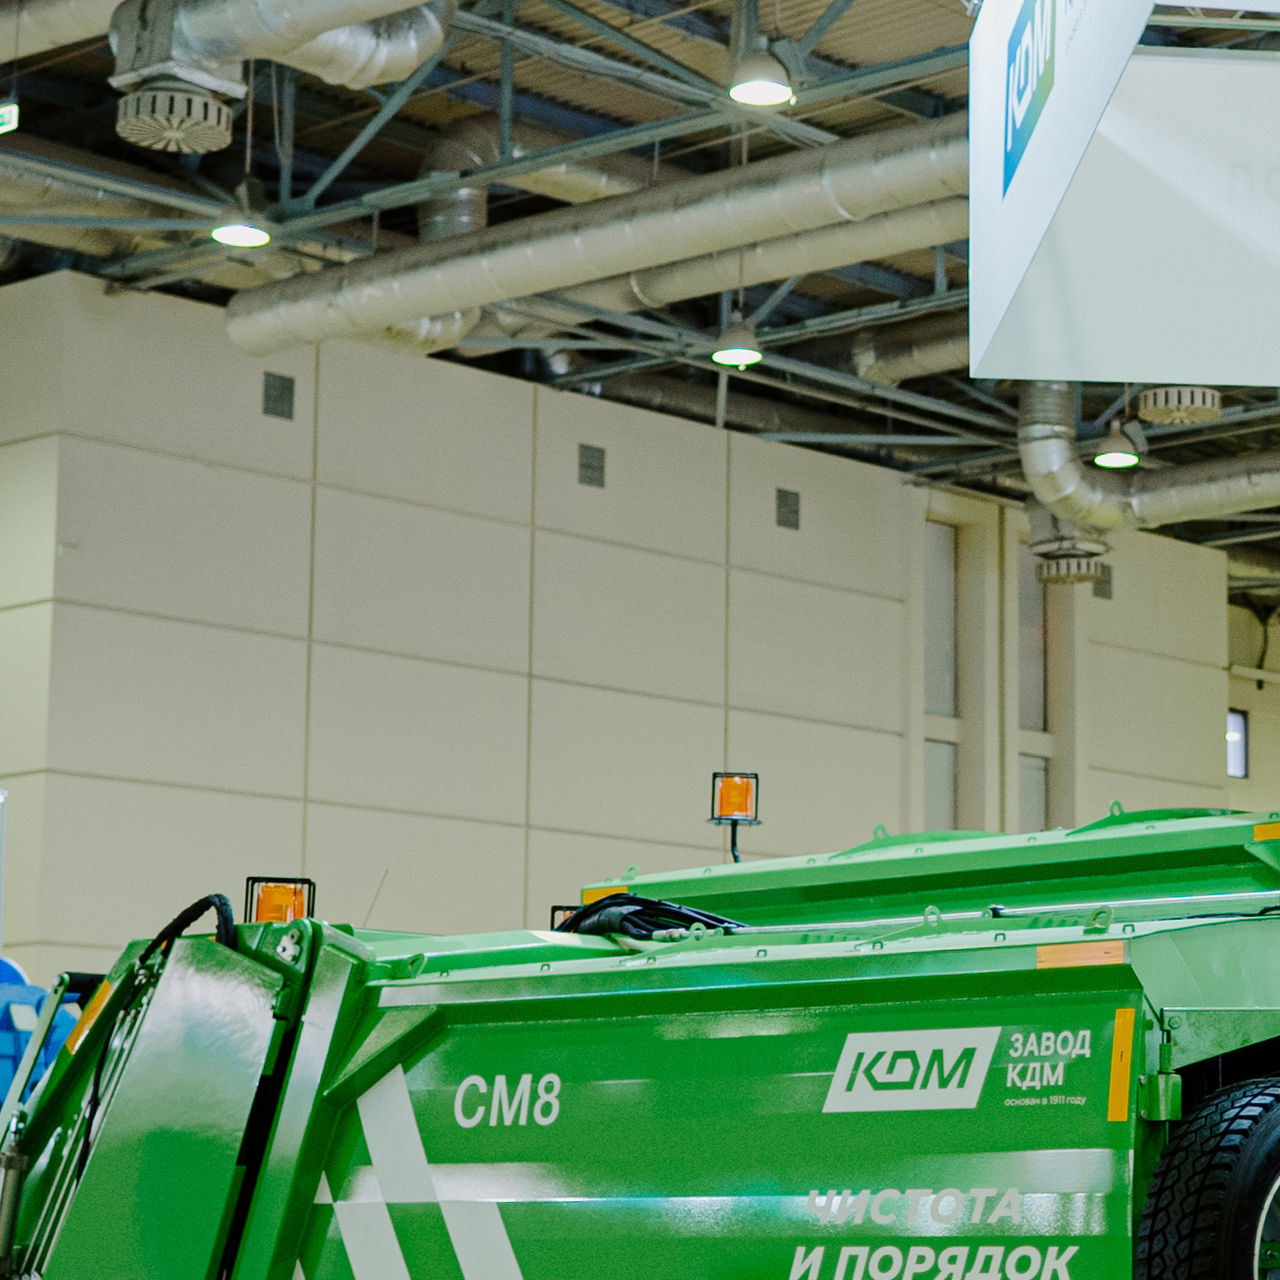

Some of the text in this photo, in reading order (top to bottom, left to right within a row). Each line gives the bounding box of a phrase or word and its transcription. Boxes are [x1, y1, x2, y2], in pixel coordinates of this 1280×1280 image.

[1009, 1030, 1091, 1057] ЗАВОД
[1006, 1063, 1064, 1090] КДМ
[1004, 1096, 1040, 1107] основан
[1049, 1095, 1065, 1105] 1911
[1067, 1096, 1087, 1106] году
[806, 1188, 1023, 1225] ЧИСТОТА
